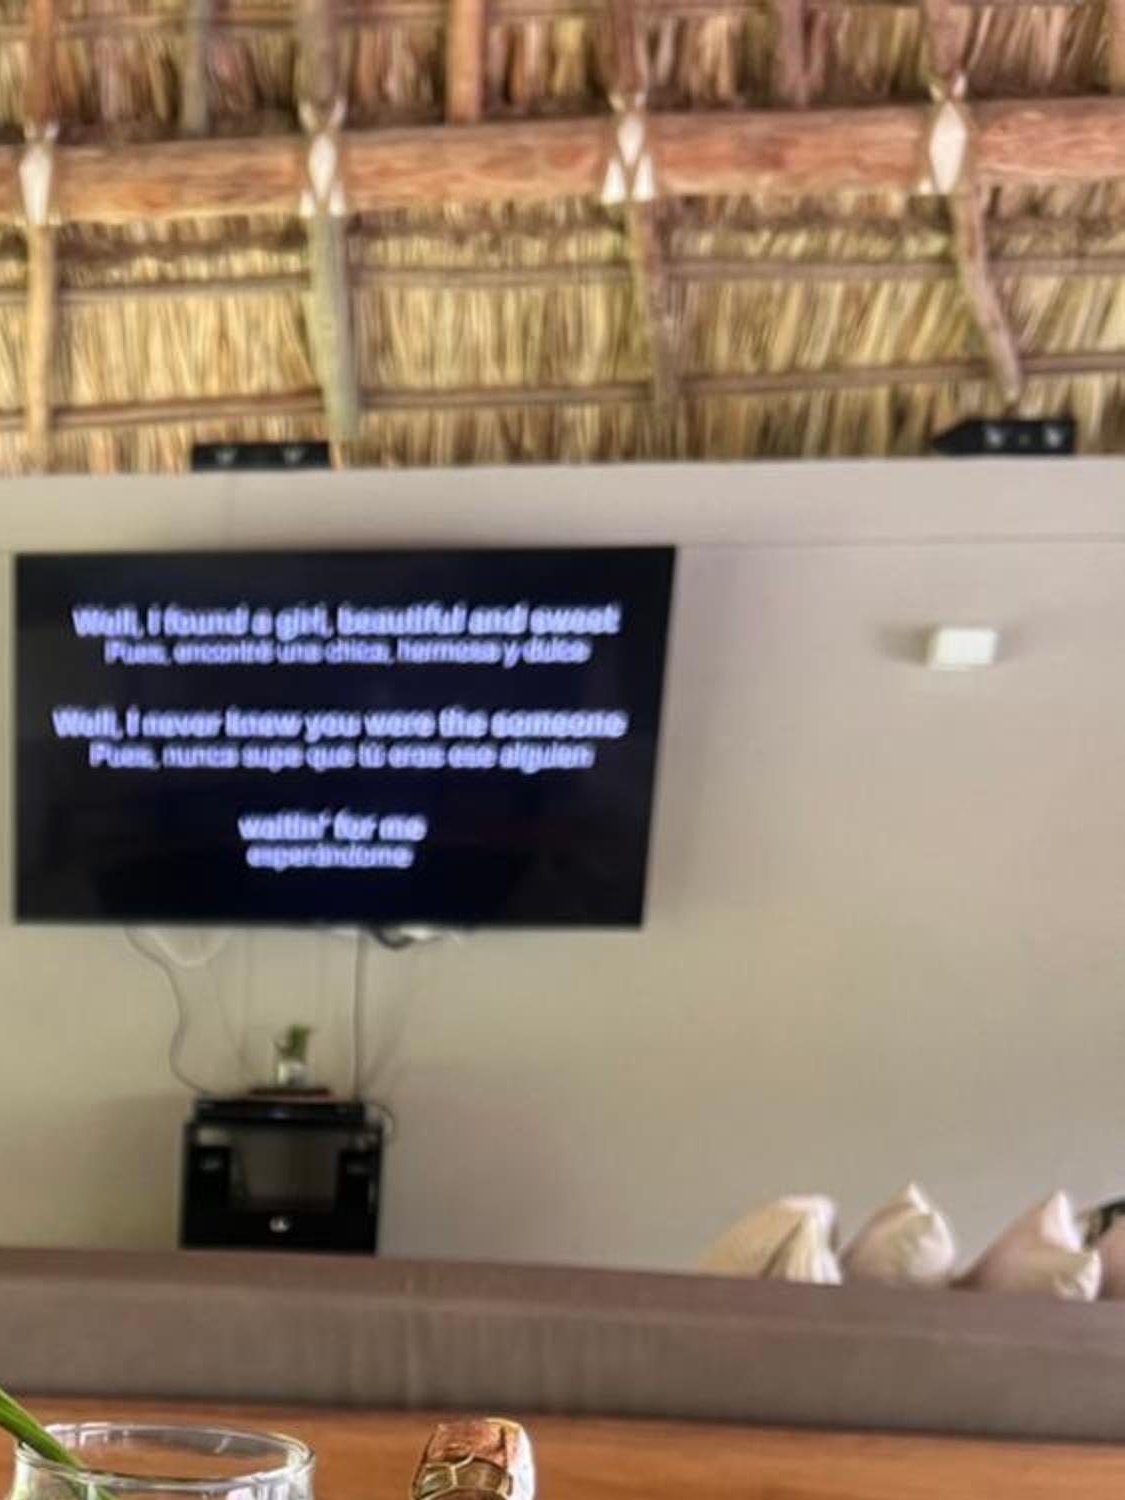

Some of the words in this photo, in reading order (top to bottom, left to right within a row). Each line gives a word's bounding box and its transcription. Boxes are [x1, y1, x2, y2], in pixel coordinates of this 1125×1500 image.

[72, 604, 145, 639] Well,
[147, 604, 162, 636] I
[164, 603, 249, 636] found
[251, 610, 273, 636] a
[275, 603, 334, 641] girl,
[337, 601, 467, 635] beautiful
[469, 601, 528, 635] and
[530, 602, 621, 635] sweet
[277, 641, 324, 664] una
[396, 636, 501, 664] hermosa
[502, 640, 522, 669] y
[523, 636, 591, 664] dulce
[53, 705, 124, 740] Well,
[126, 704, 140, 737] I
[142, 710, 223, 737] never
[225, 705, 303, 737] knew
[304, 711, 361, 743] you
[364, 710, 436, 737] were
[438, 705, 488, 738] the
[491, 710, 628, 738] someone
[162, 744, 239, 769] nunca
[241, 744, 304, 772] supe
[306, 744, 356, 772] que
[387, 744, 446, 769] eras
[448, 744, 497, 769] ese
[499, 741, 595, 774] alguien
[333, 806, 377, 841] for
[379, 813, 427, 841] me
